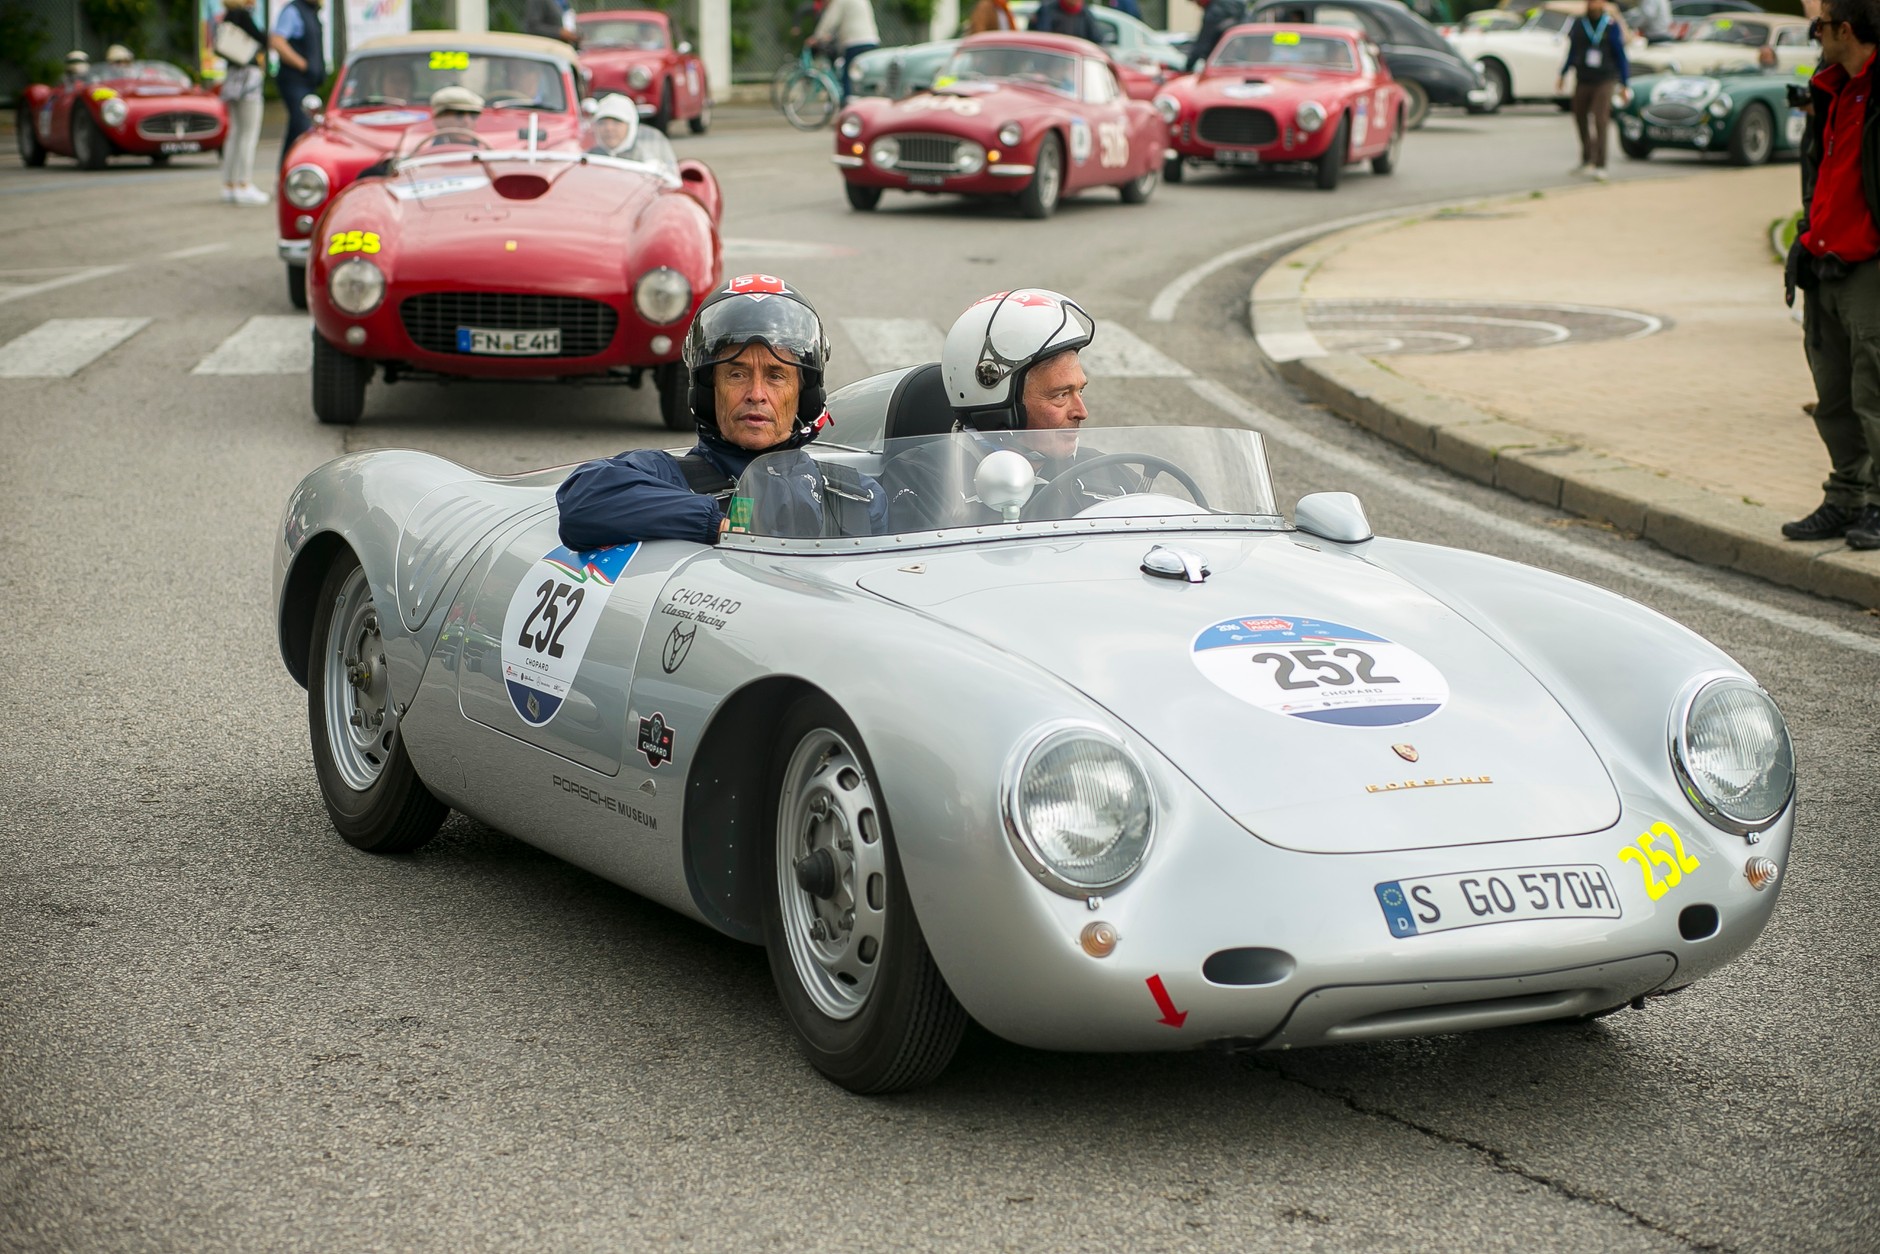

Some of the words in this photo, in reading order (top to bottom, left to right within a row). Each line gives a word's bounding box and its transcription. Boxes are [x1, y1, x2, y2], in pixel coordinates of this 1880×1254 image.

[328, 230, 382, 256] 255
[470, 332, 501, 350] FN
[513, 332, 559, 351] E4H
[671, 587, 742, 615] CHOPARD
[518, 578, 586, 659] 252
[661, 602, 695, 621] Classic
[693, 609, 728, 632] Racing
[525, 656, 550, 673] CHOPARD
[1251, 647, 1401, 692] 252
[1321, 688, 1383, 697] CHOPARD
[642, 740, 668, 758] CHOPARD
[1364, 775, 1494, 793] PORSCHE
[552, 774, 617, 812] PORSCHE
[616, 801, 659, 831] MUSEUM
[1616, 820, 1702, 903] 252
[1411, 884, 1441, 925] S
[1459, 877, 1517, 918] GO
[1397, 916, 1409, 932] D
